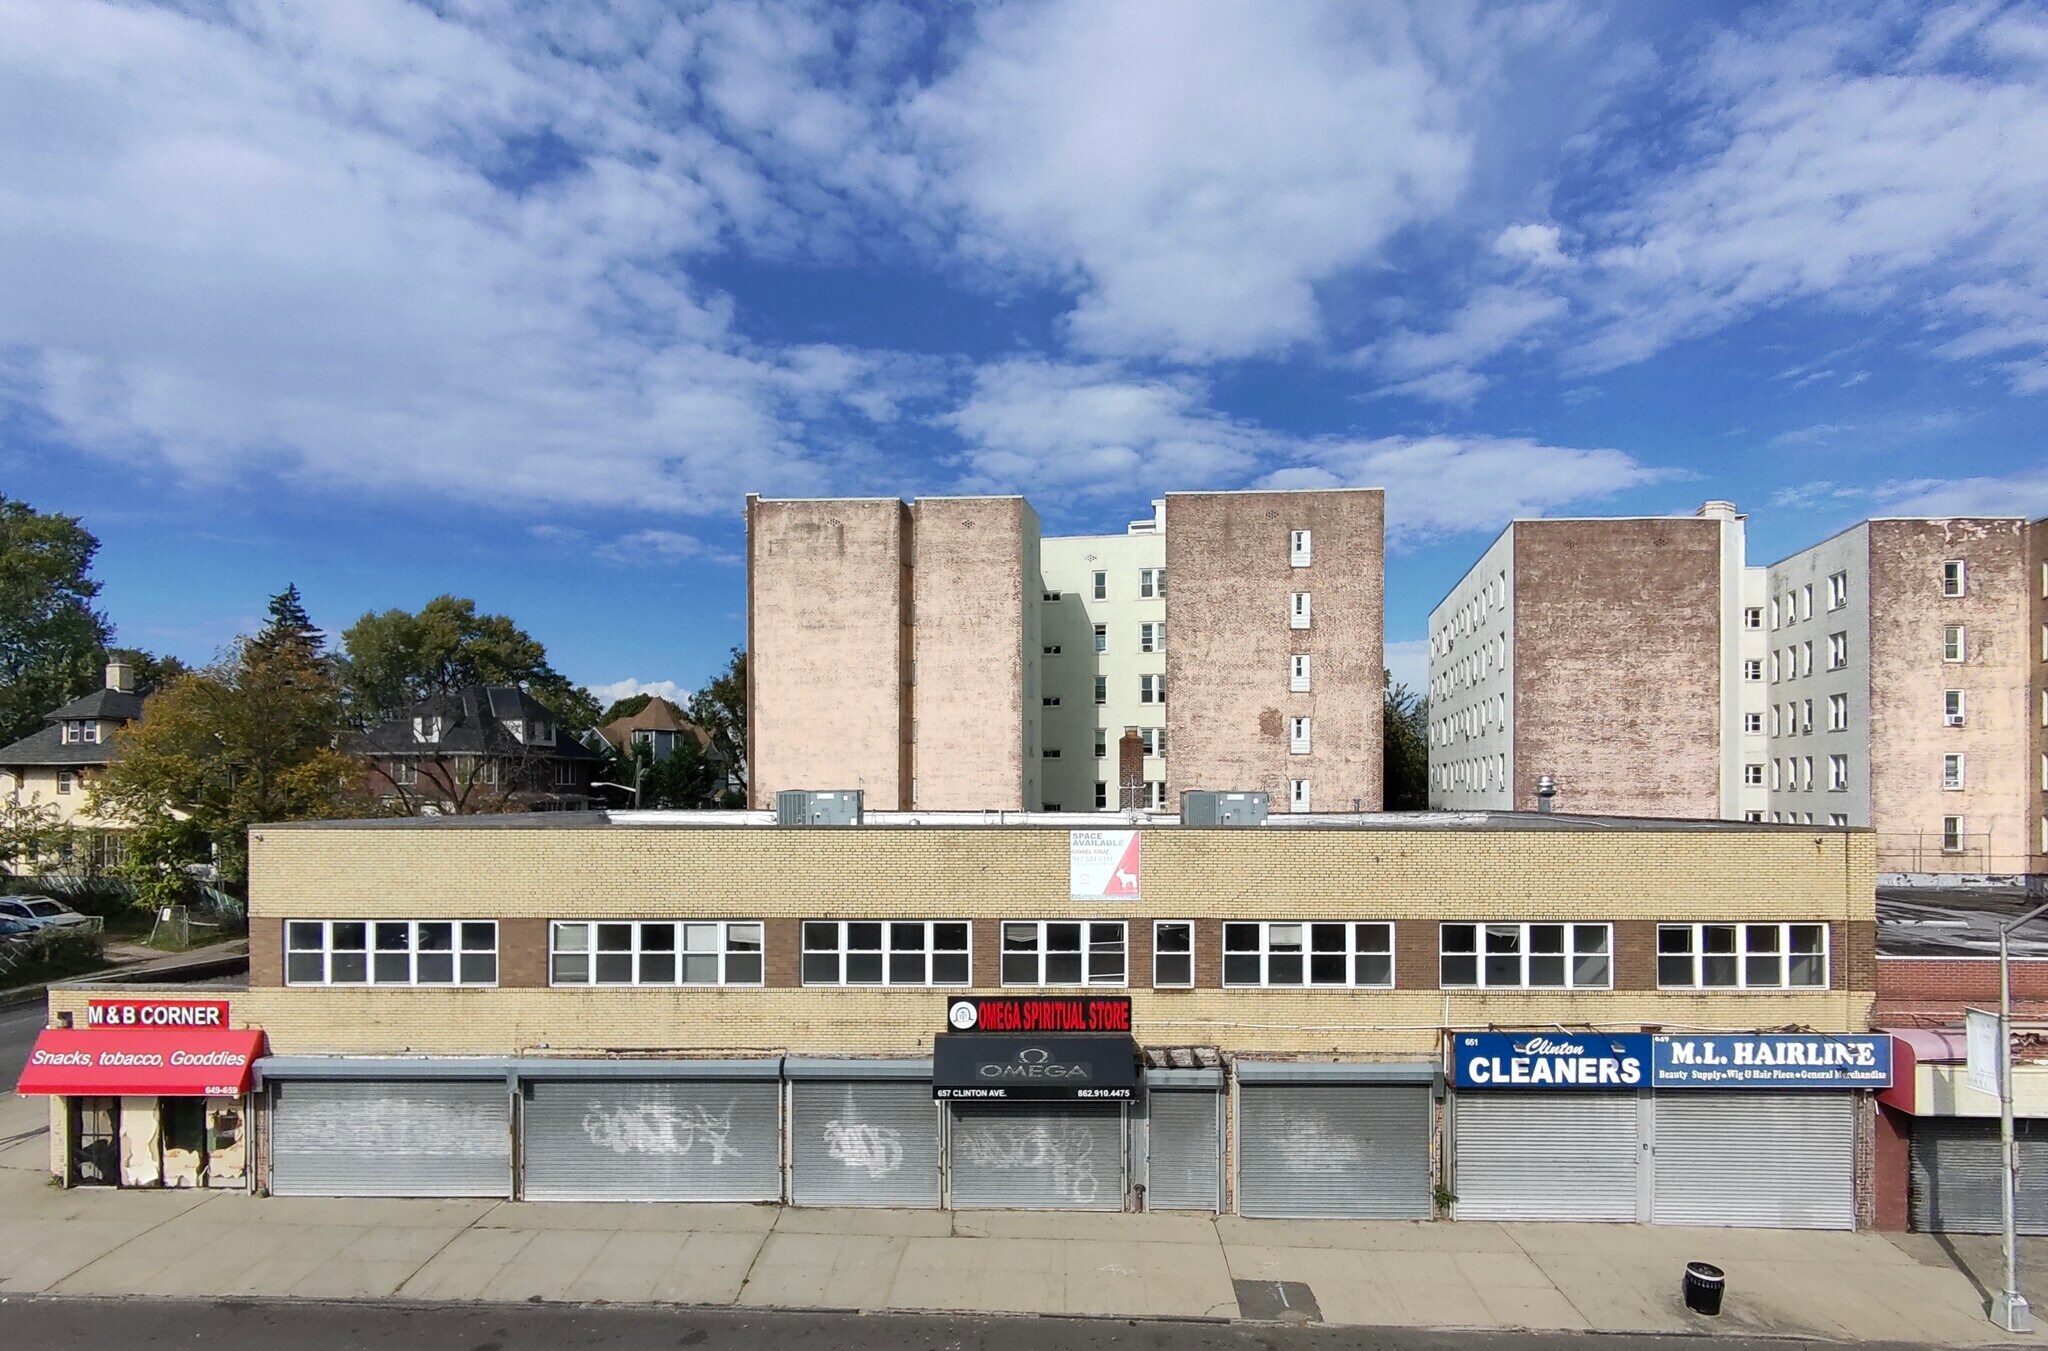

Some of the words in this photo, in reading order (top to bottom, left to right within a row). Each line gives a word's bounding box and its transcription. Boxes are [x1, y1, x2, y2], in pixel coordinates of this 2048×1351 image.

[88, 1006, 103, 1024] M
[106, 1006, 120, 1024] &
[123, 1006, 135, 1024] B
[141, 1006, 220, 1025] CORNER
[978, 1001, 1021, 1030] OMEGA
[1023, 1002, 1086, 1030] SPIRITUAL
[1089, 1002, 1130, 1030] STORE
[1465, 1038, 1478, 1046] 651
[1525, 1037, 1584, 1055] Clinton
[31, 1050, 94, 1067] Snacks,
[99, 1051, 164, 1067] tobacco,
[170, 1050, 246, 1067] Gooddies
[1671, 1042, 1728, 1065] M.L.
[1733, 1042, 1876, 1066] HAIRLINE
[979, 1064, 1088, 1078] OMEGA
[1468, 1056, 1641, 1084] CLEANERS
[1659, 1070, 1688, 1080] Beauty
[1691, 1070, 1721, 1080] Supply
[1726, 1069, 1744, 1080] Wig
[1752, 1069, 1772, 1079] Hair
[1801, 1070, 1833, 1079] General
[1834, 1070, 1887, 1079] Merchandise
[205, 1086, 238, 1094] 649-659
[937, 1089, 951, 1097] 657
[952, 1089, 988, 1097] CLINTON
[989, 1089, 1007, 1097] AVE.
[1077, 1089, 1130, 1097] 862.910.4475
